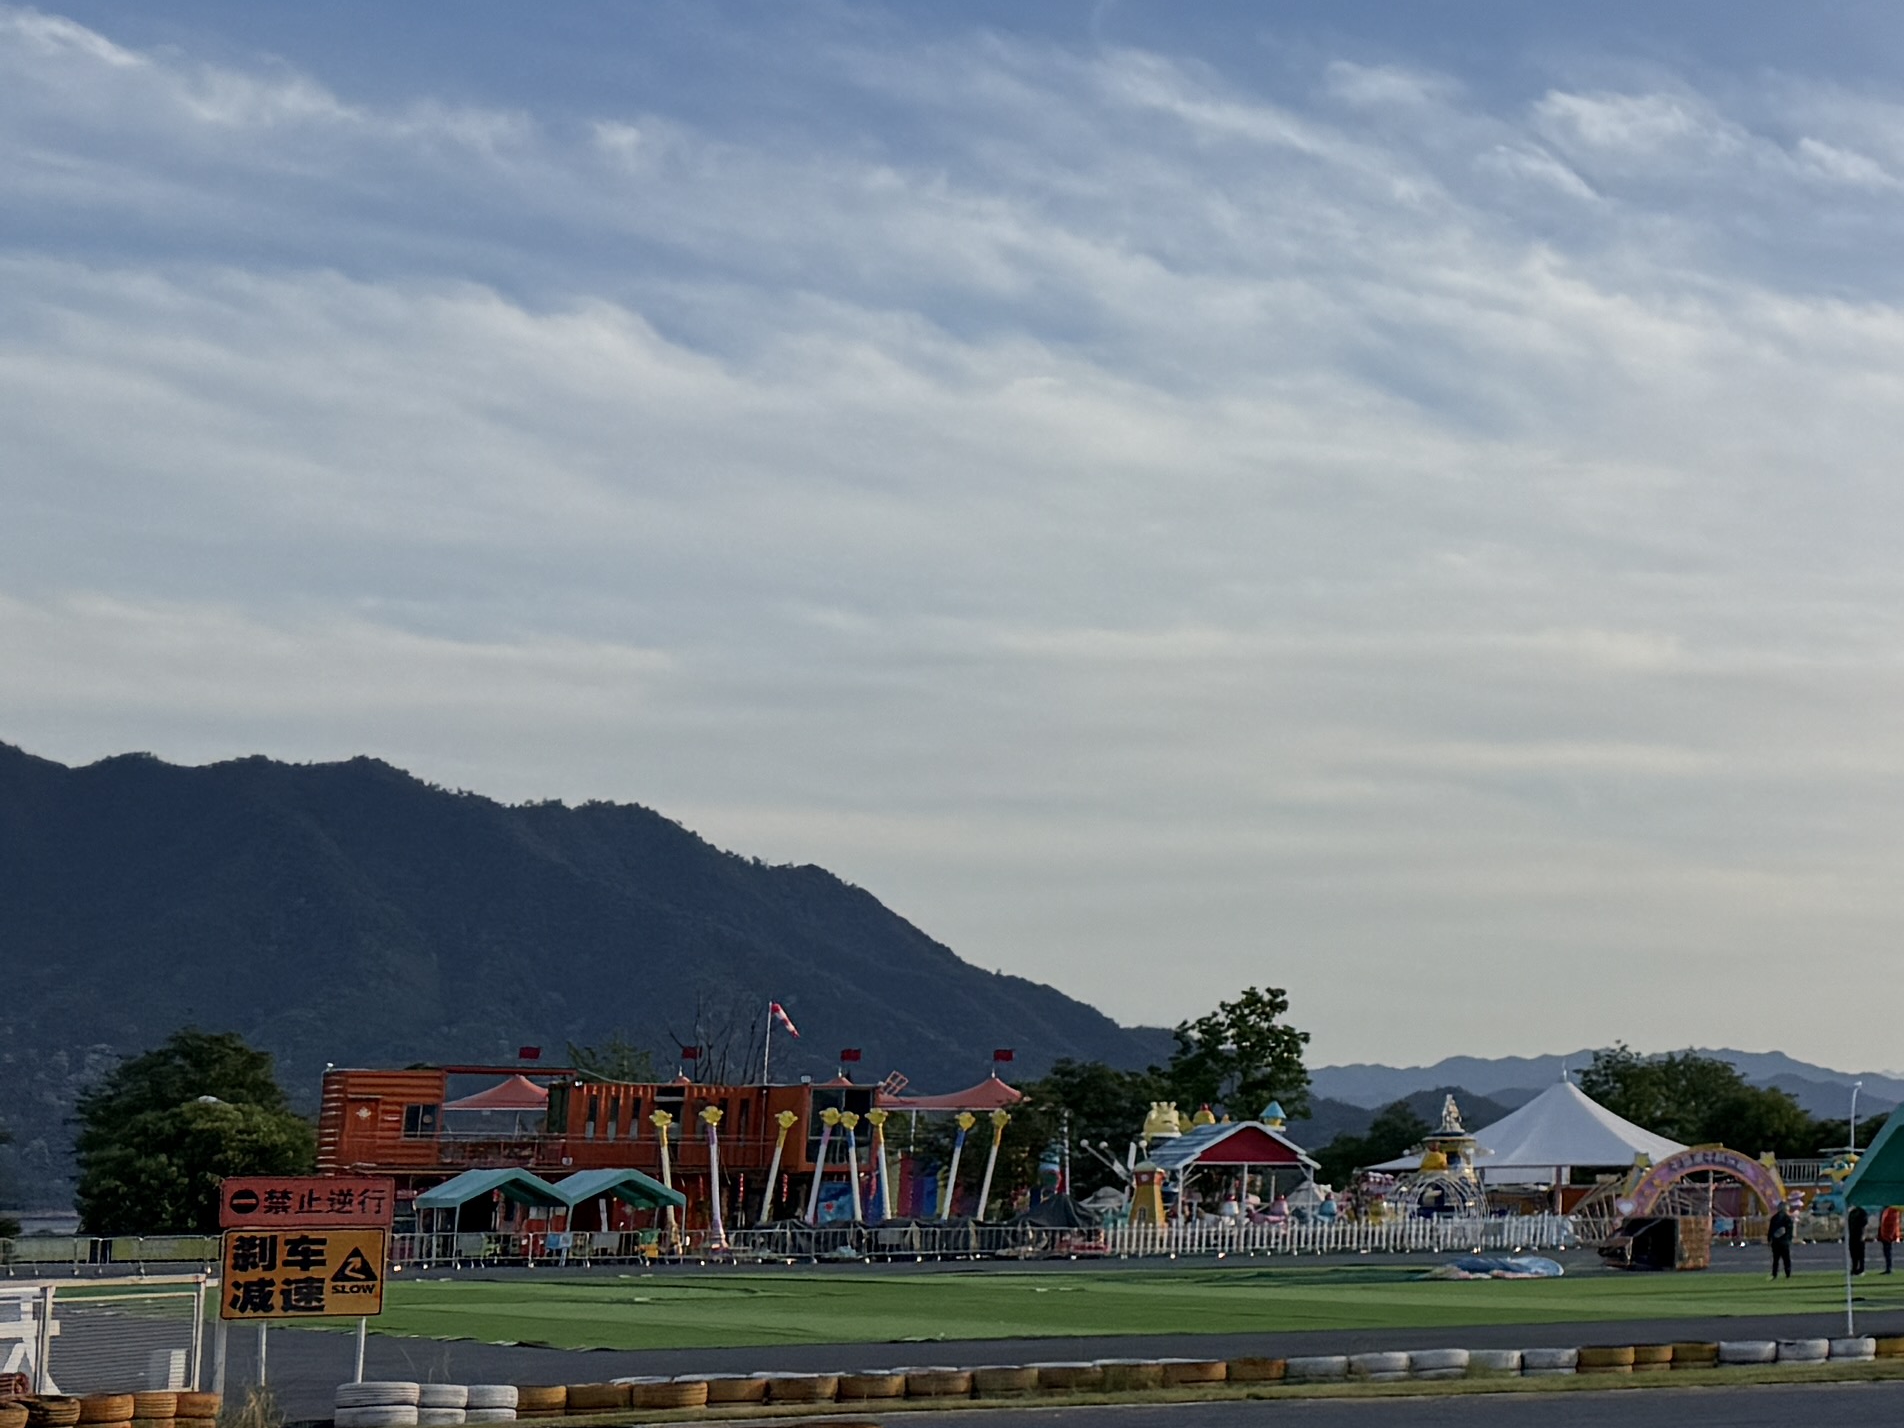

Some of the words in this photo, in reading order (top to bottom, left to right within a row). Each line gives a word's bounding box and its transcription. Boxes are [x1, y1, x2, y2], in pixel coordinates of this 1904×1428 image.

[263, 1188, 387, 1214] 禁止逆行
[231, 1234, 327, 1272] 刹车
[229, 1277, 325, 1313] 减速
[331, 1283, 375, 1295] SLOW
